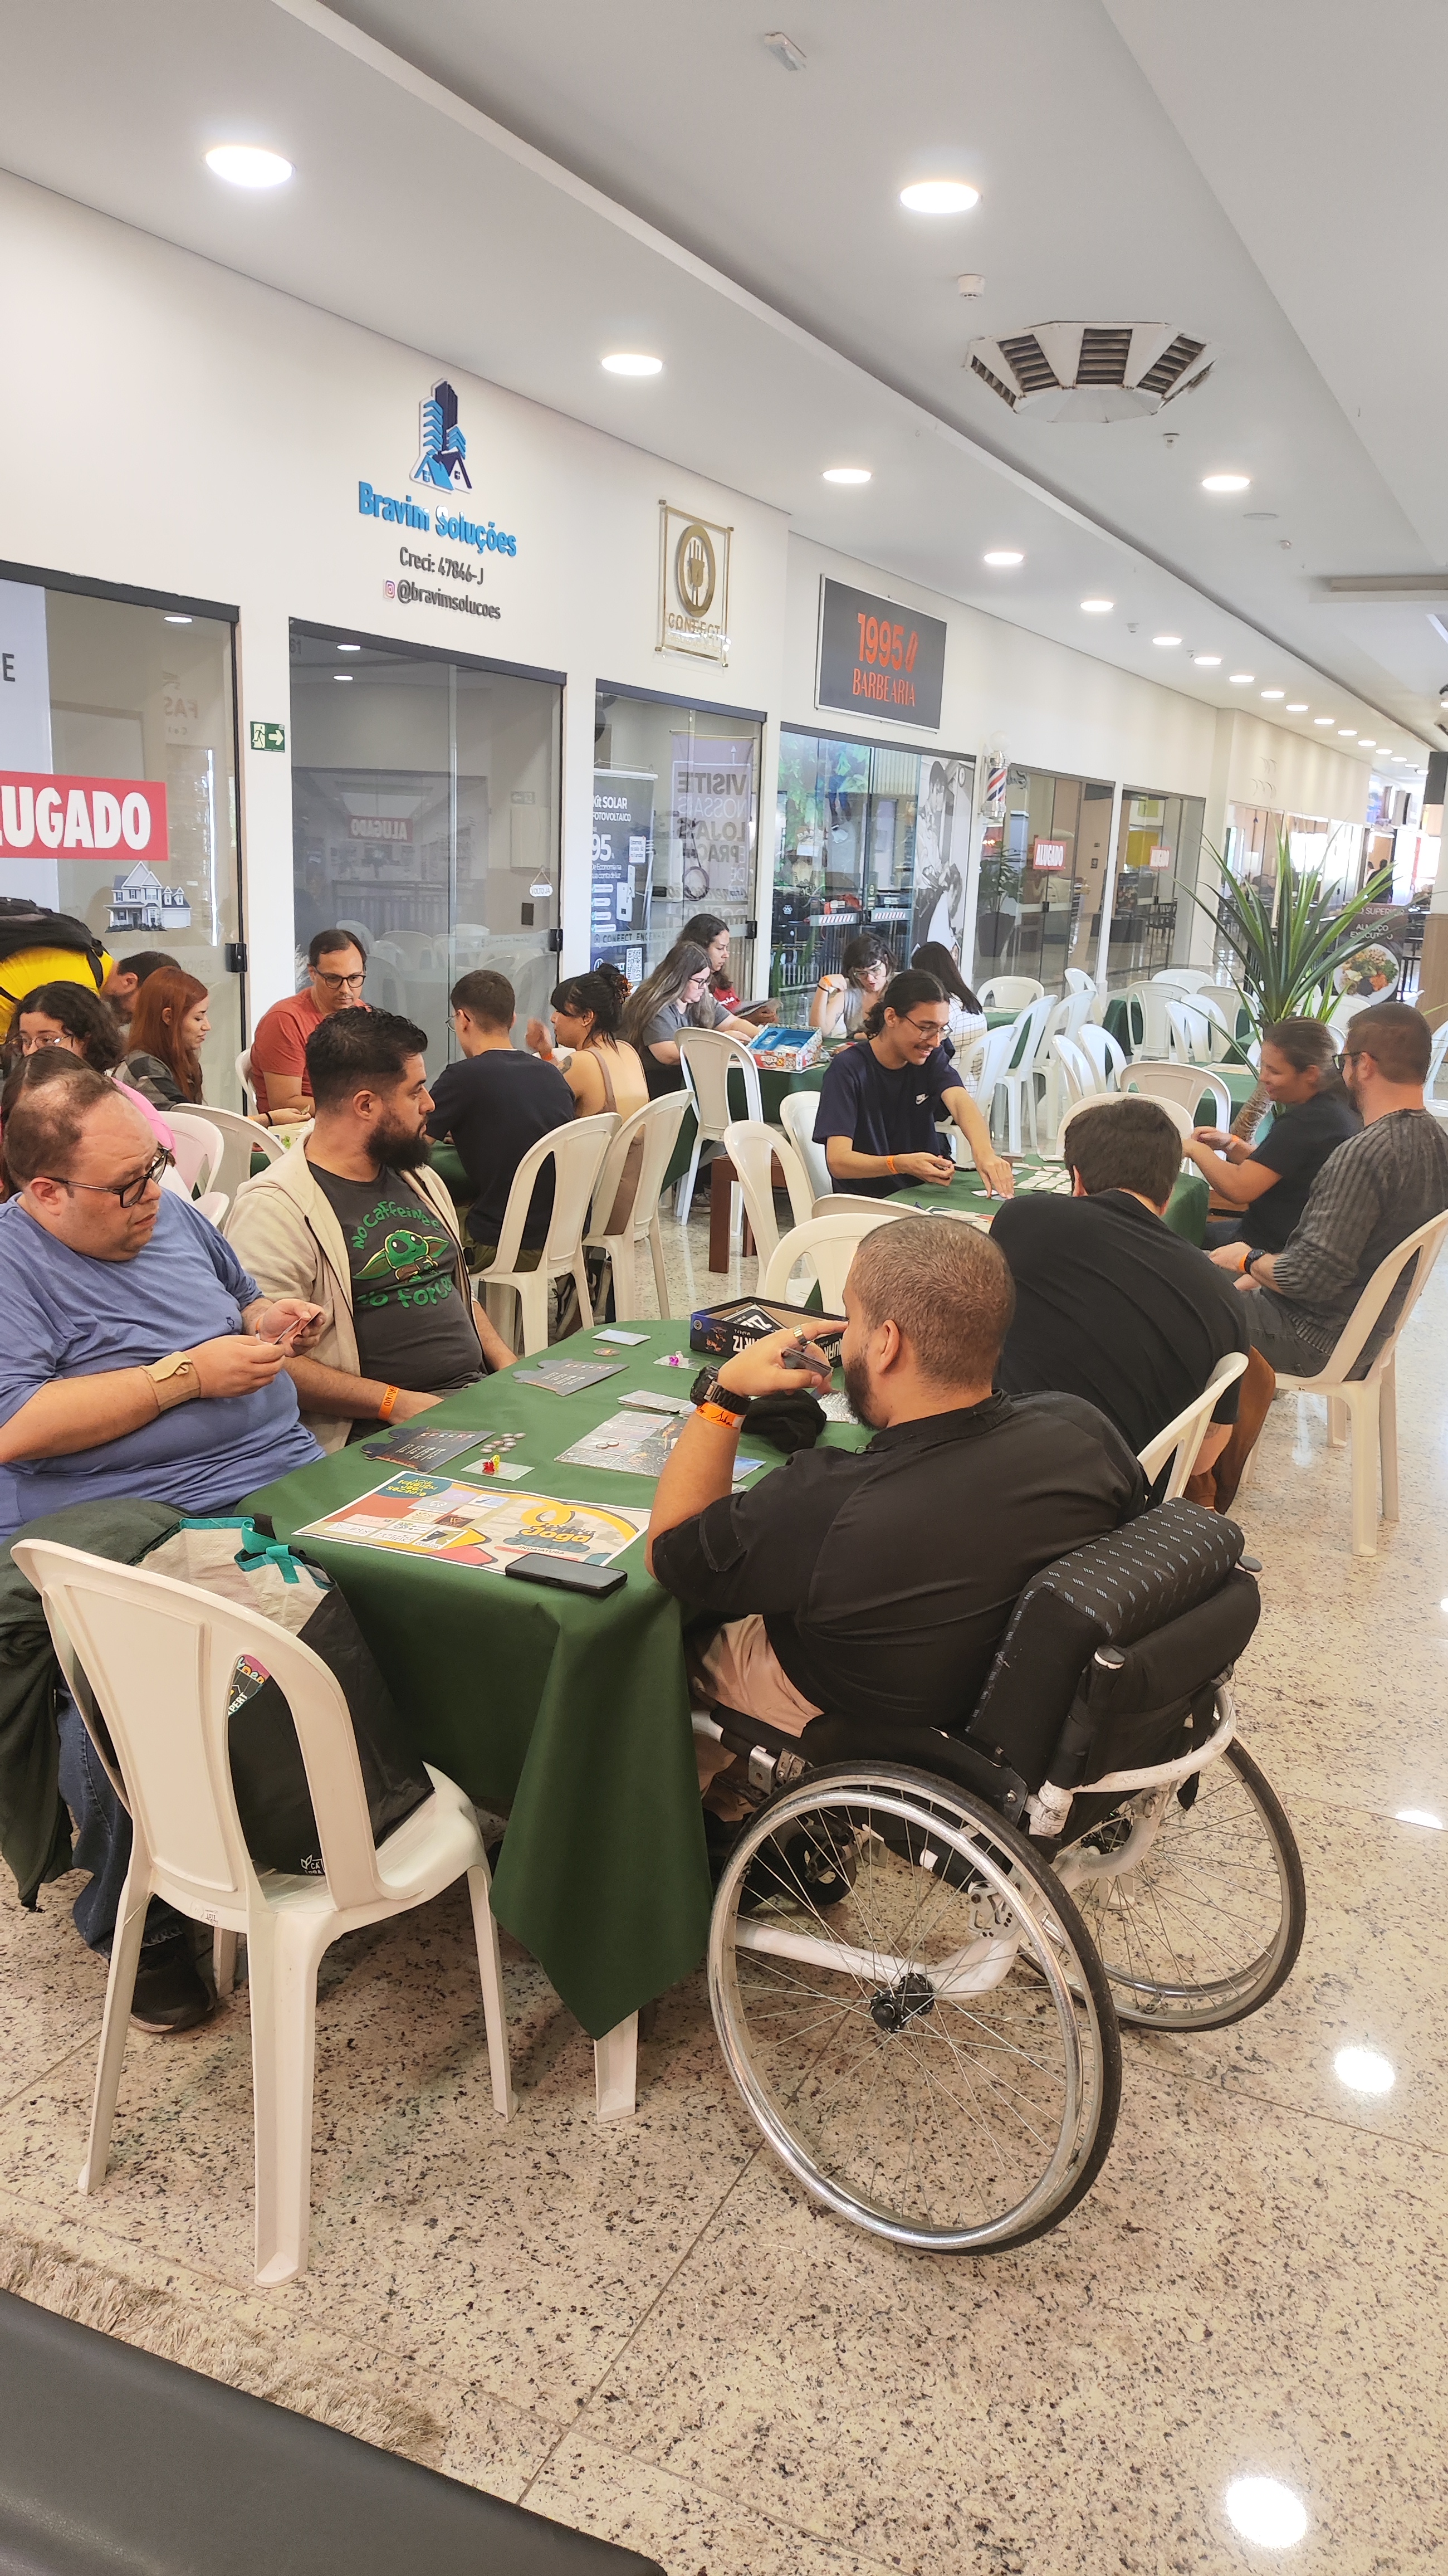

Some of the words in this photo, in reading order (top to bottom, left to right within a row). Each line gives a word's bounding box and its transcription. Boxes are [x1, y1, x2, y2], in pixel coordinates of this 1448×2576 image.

[359, 481, 429, 531] Bravim
[436, 505, 516, 557] Soluções
[400, 547, 436, 573] Creci:
[397, 579, 501, 619] @bravimsolucoes
[852, 668, 916, 707] BARBEARIA
[0, 785, 151, 850] UGADO
[603, 796, 628, 809] SOLAR
[518, 1525, 594, 1543] Joga
[518, 1545, 565, 1555] INDAIATUBA
